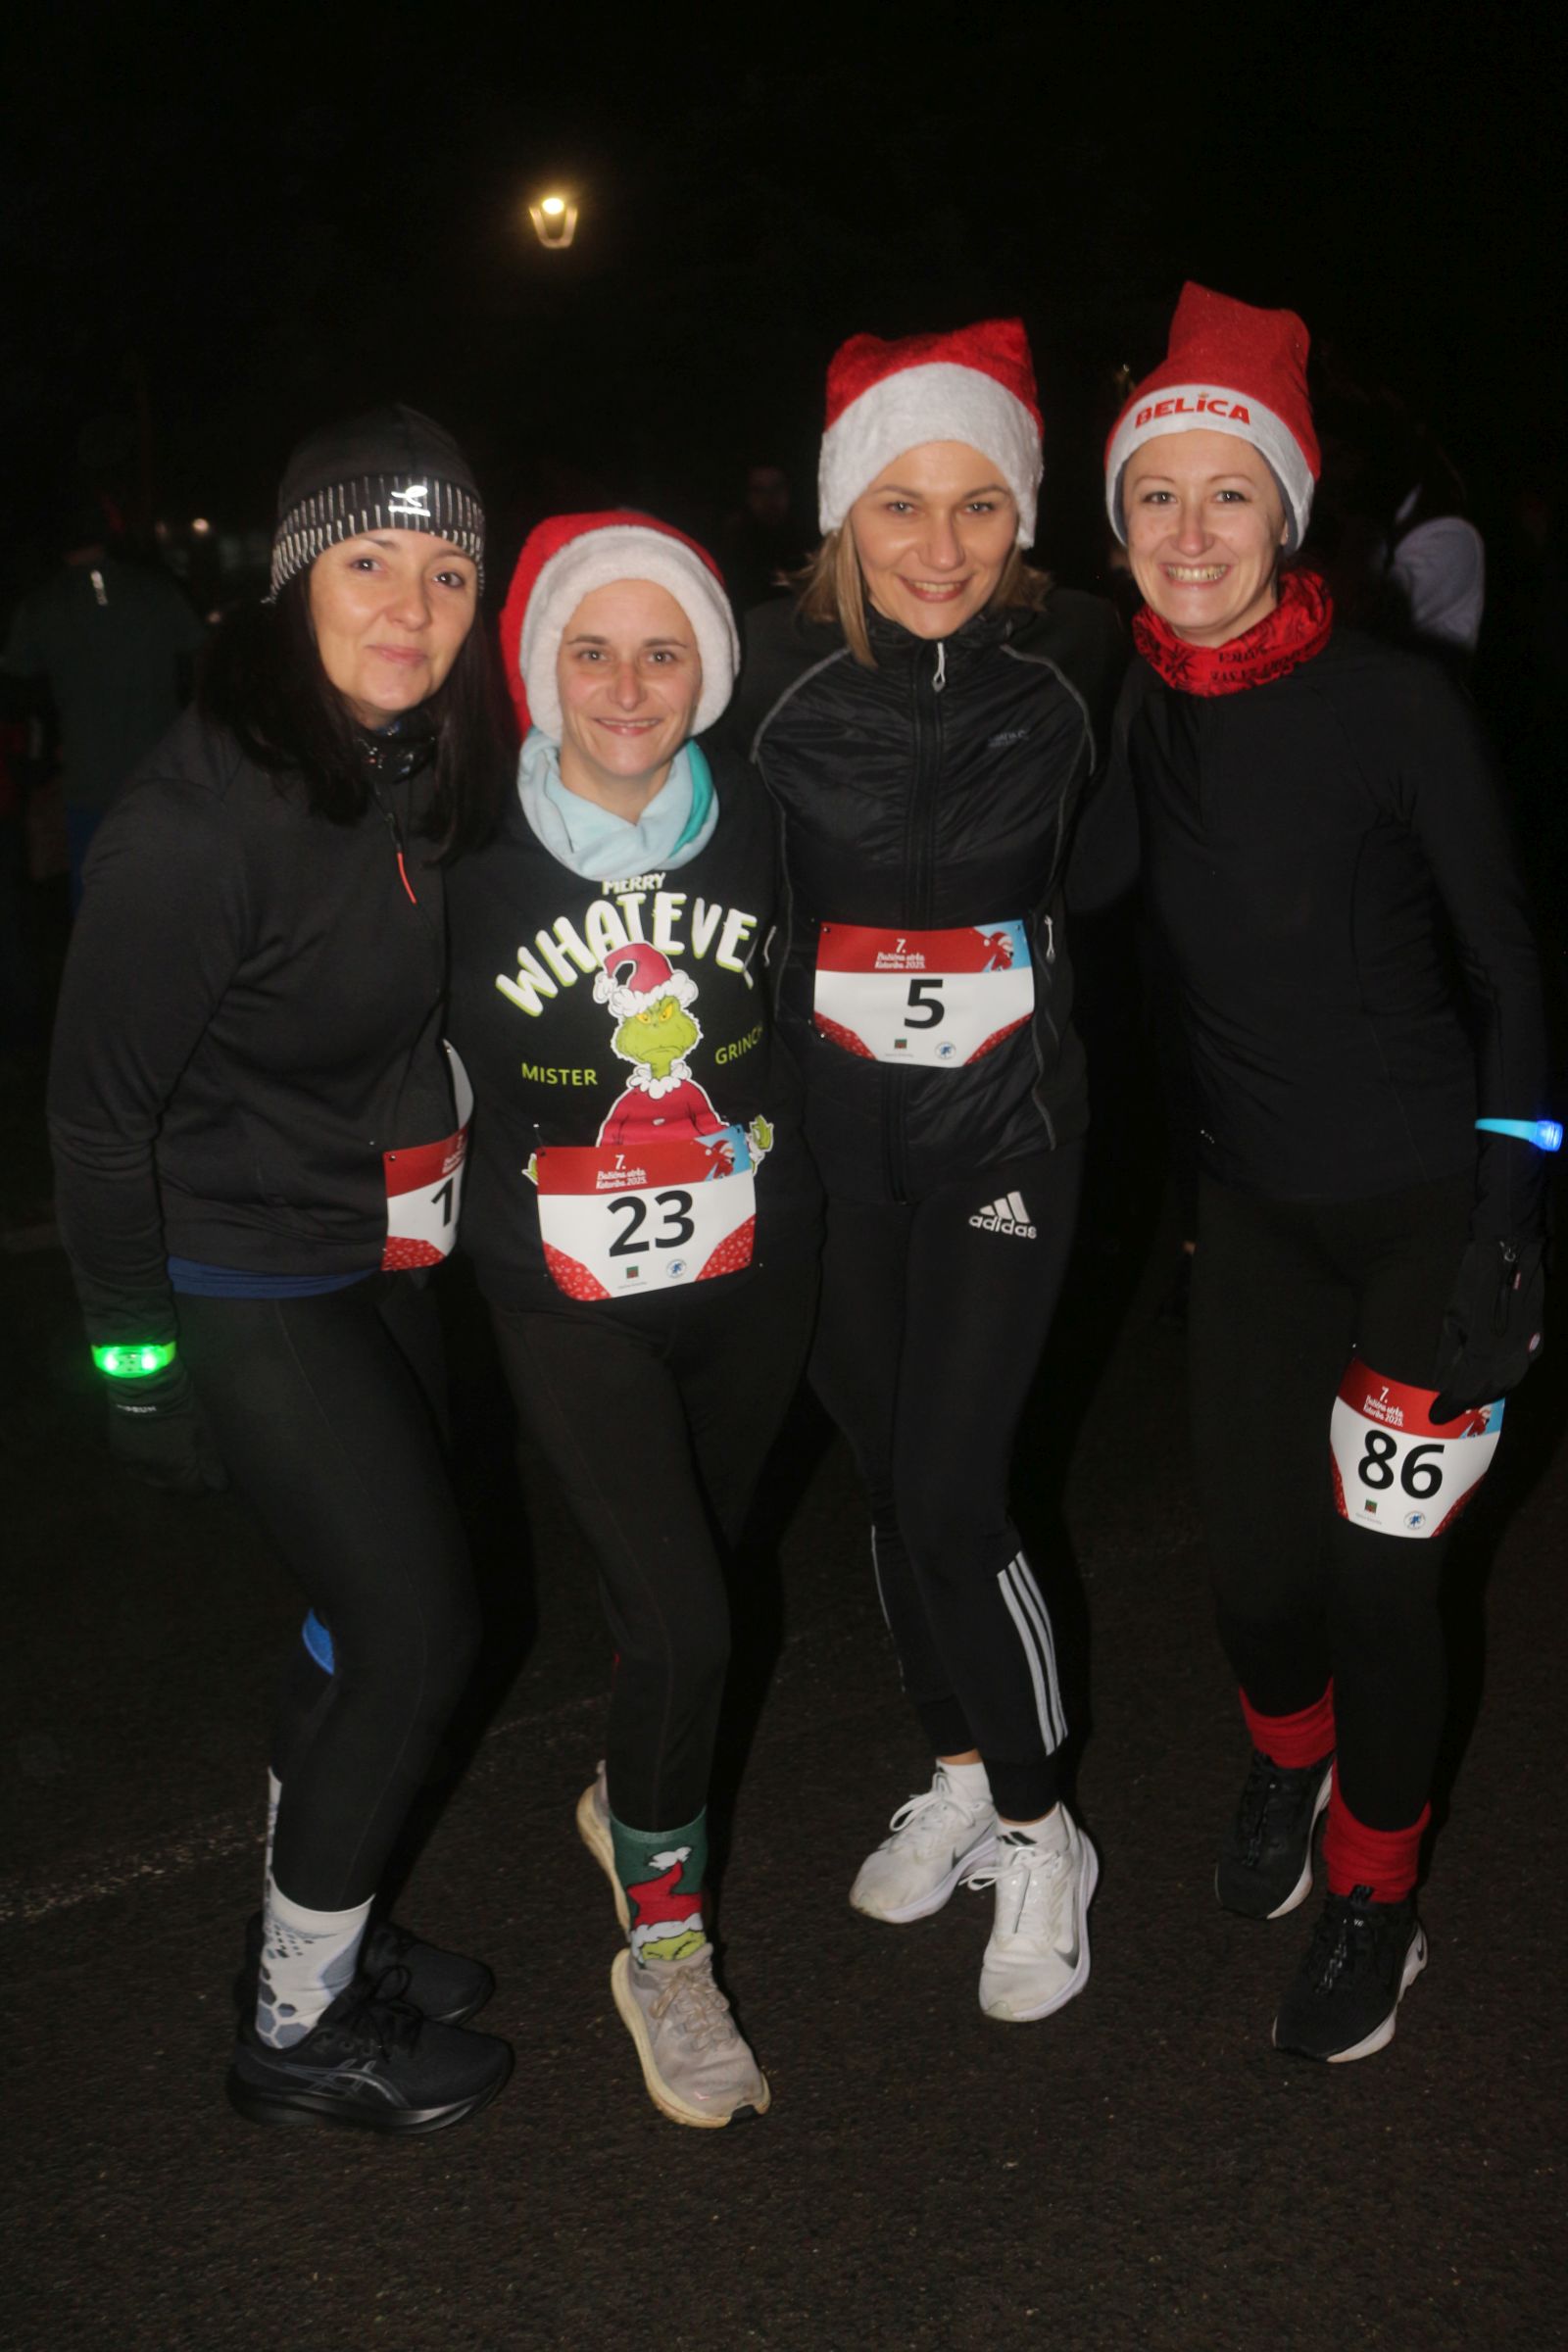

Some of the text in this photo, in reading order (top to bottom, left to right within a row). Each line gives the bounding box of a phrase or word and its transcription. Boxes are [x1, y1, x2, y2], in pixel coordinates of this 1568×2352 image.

[602, 871, 666, 896] MERRY
[495, 891, 757, 1017] WHATEVE
[904, 978, 945, 1029] 5
[521, 1062, 598, 1086] MISTER
[607, 1190, 695, 1257] 23
[968, 1214, 1038, 1240] adidas
[1357, 1429, 1446, 1499] 86
